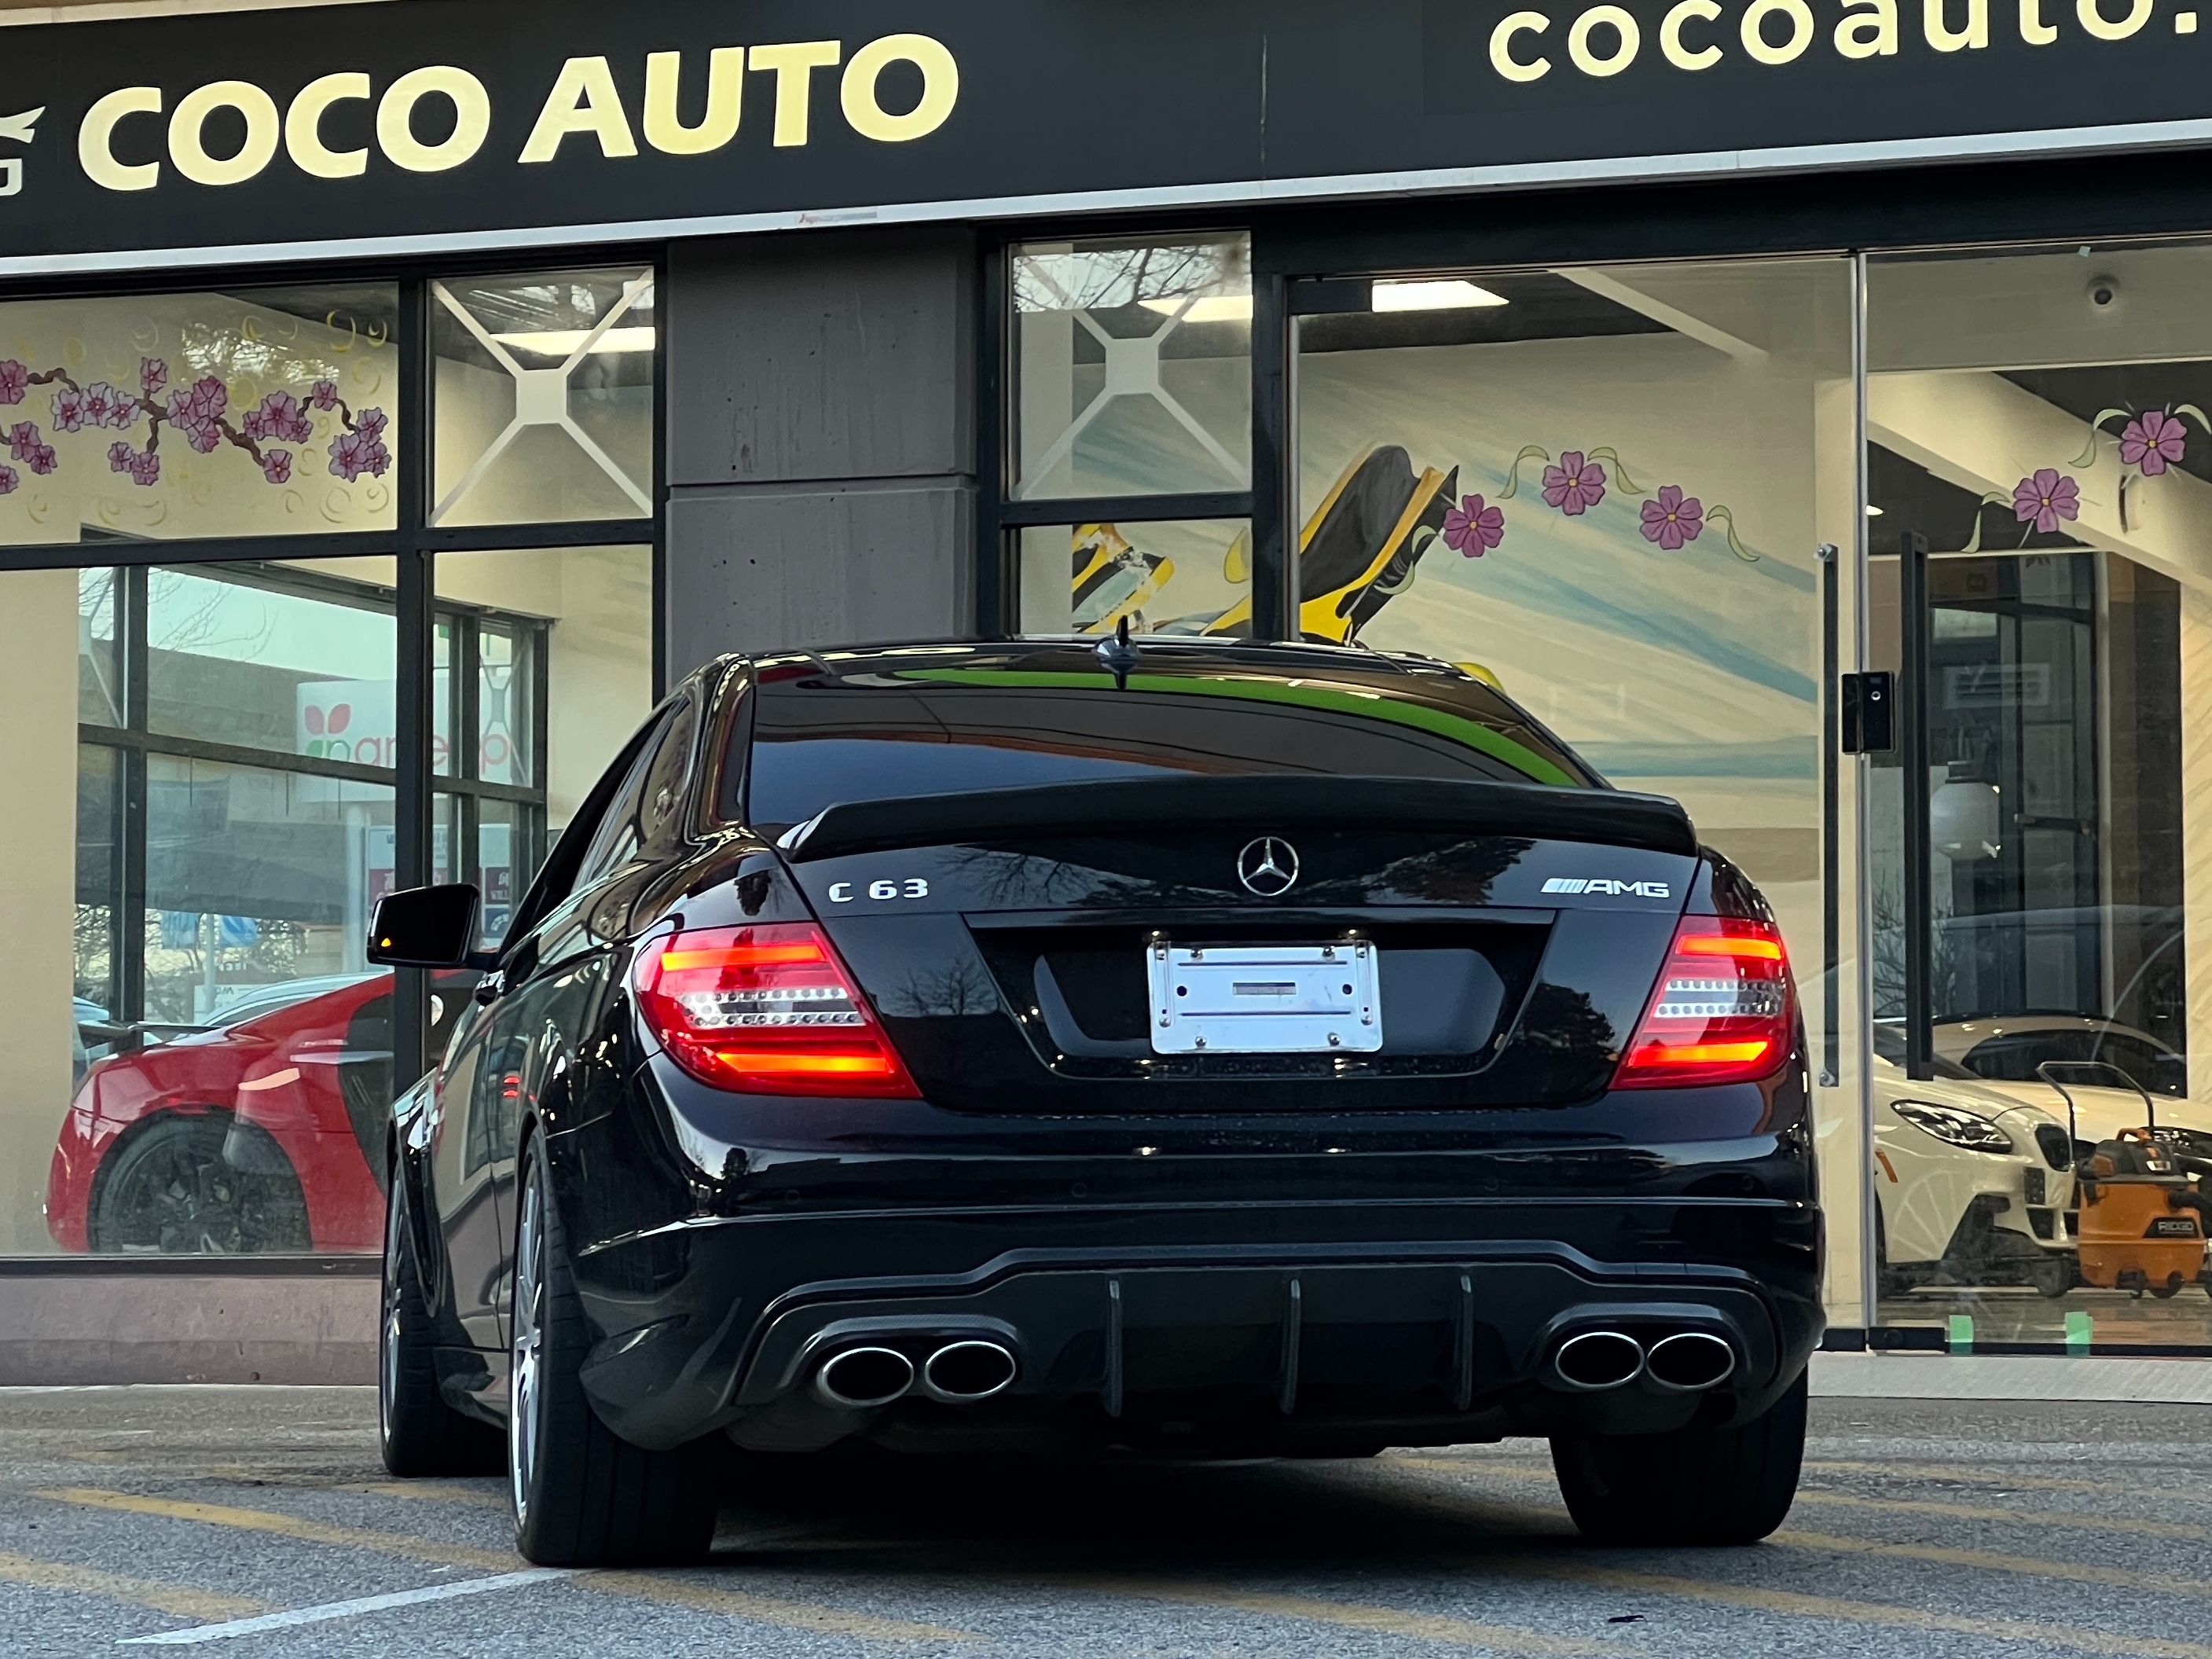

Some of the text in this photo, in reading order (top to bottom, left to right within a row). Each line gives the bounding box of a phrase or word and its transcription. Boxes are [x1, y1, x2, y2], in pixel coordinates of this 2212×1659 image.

[78, 33, 959, 191] COCO AUTO
[828, 878, 929, 903] C 63
[1583, 879, 1670, 898] AMG
